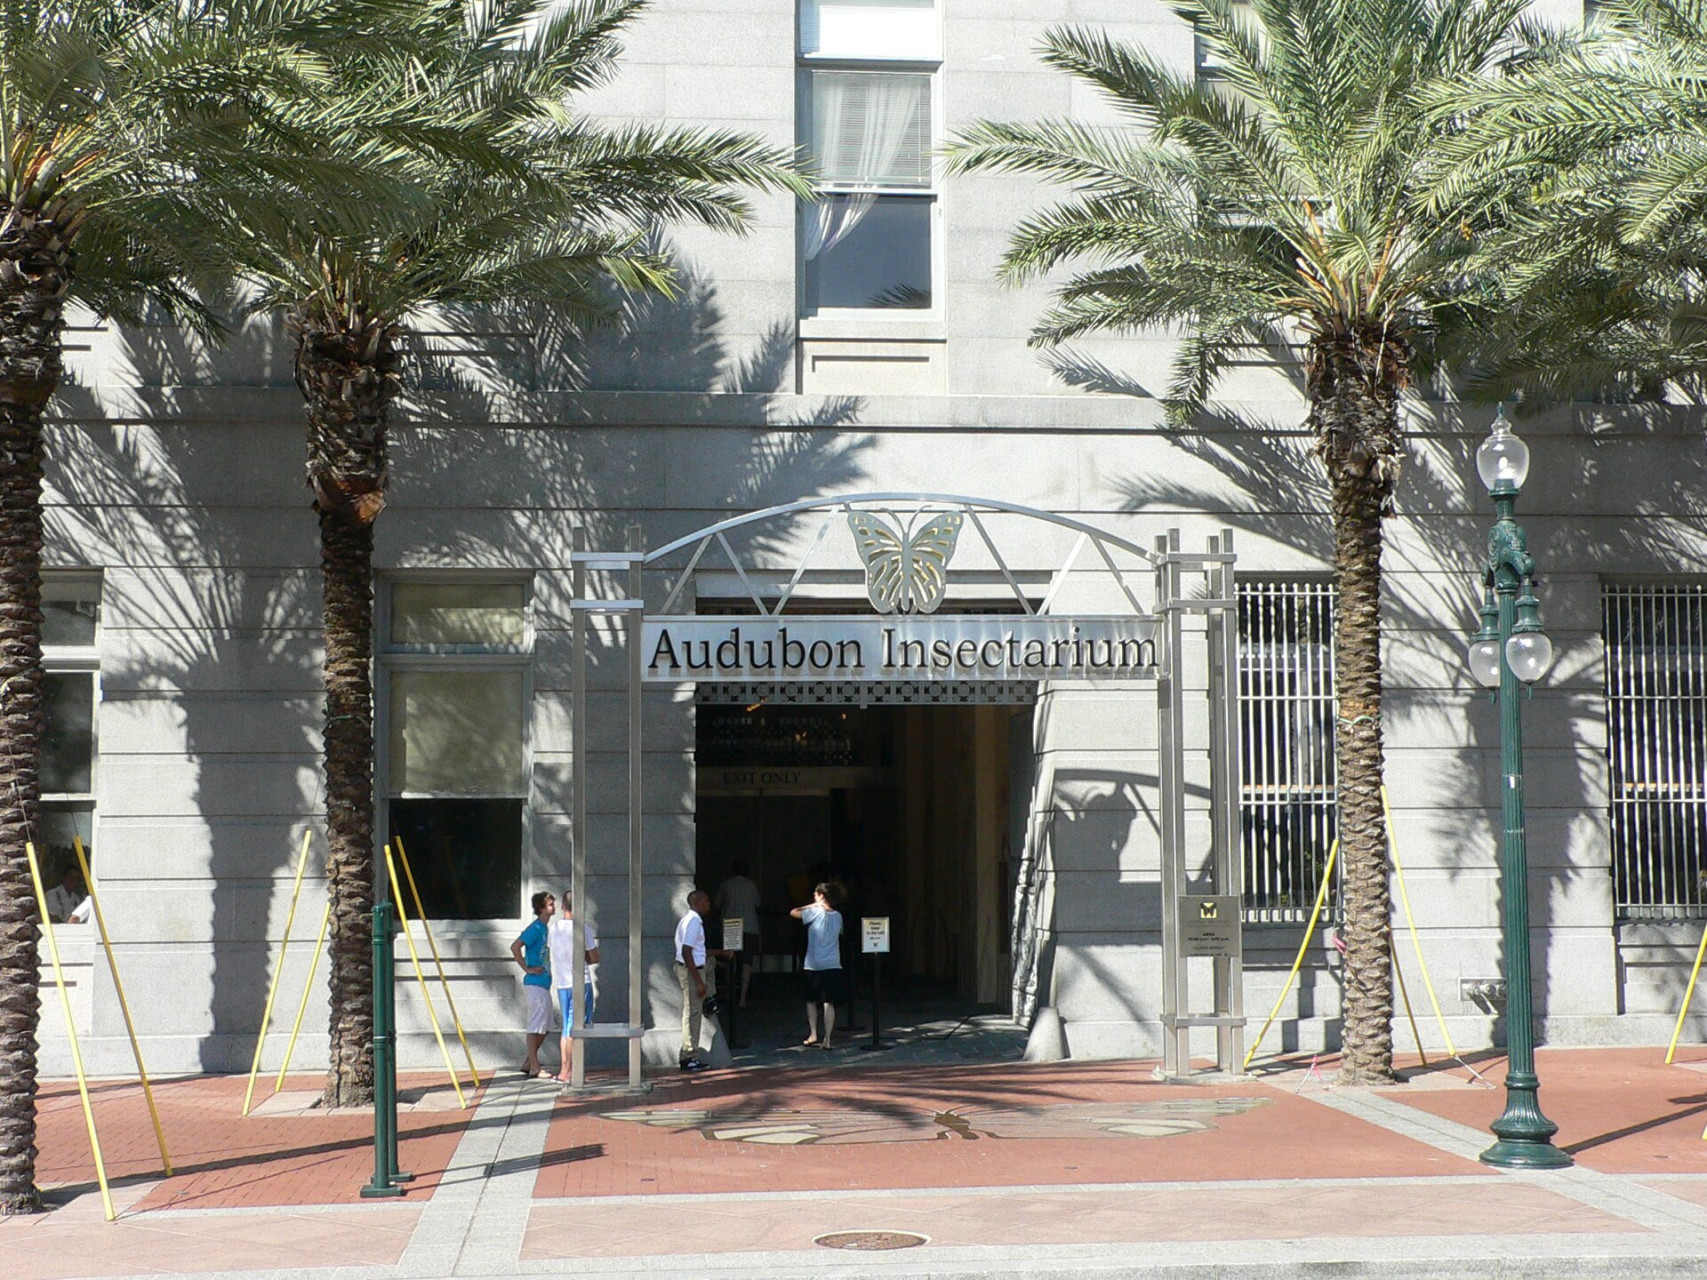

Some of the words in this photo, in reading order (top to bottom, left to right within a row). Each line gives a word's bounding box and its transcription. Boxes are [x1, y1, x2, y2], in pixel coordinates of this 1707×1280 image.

[648, 627, 866, 671] Audubon
[881, 626, 1160, 670] Insectarium
[723, 772, 757, 784] EXIT
[761, 771, 802, 784] ONLY
